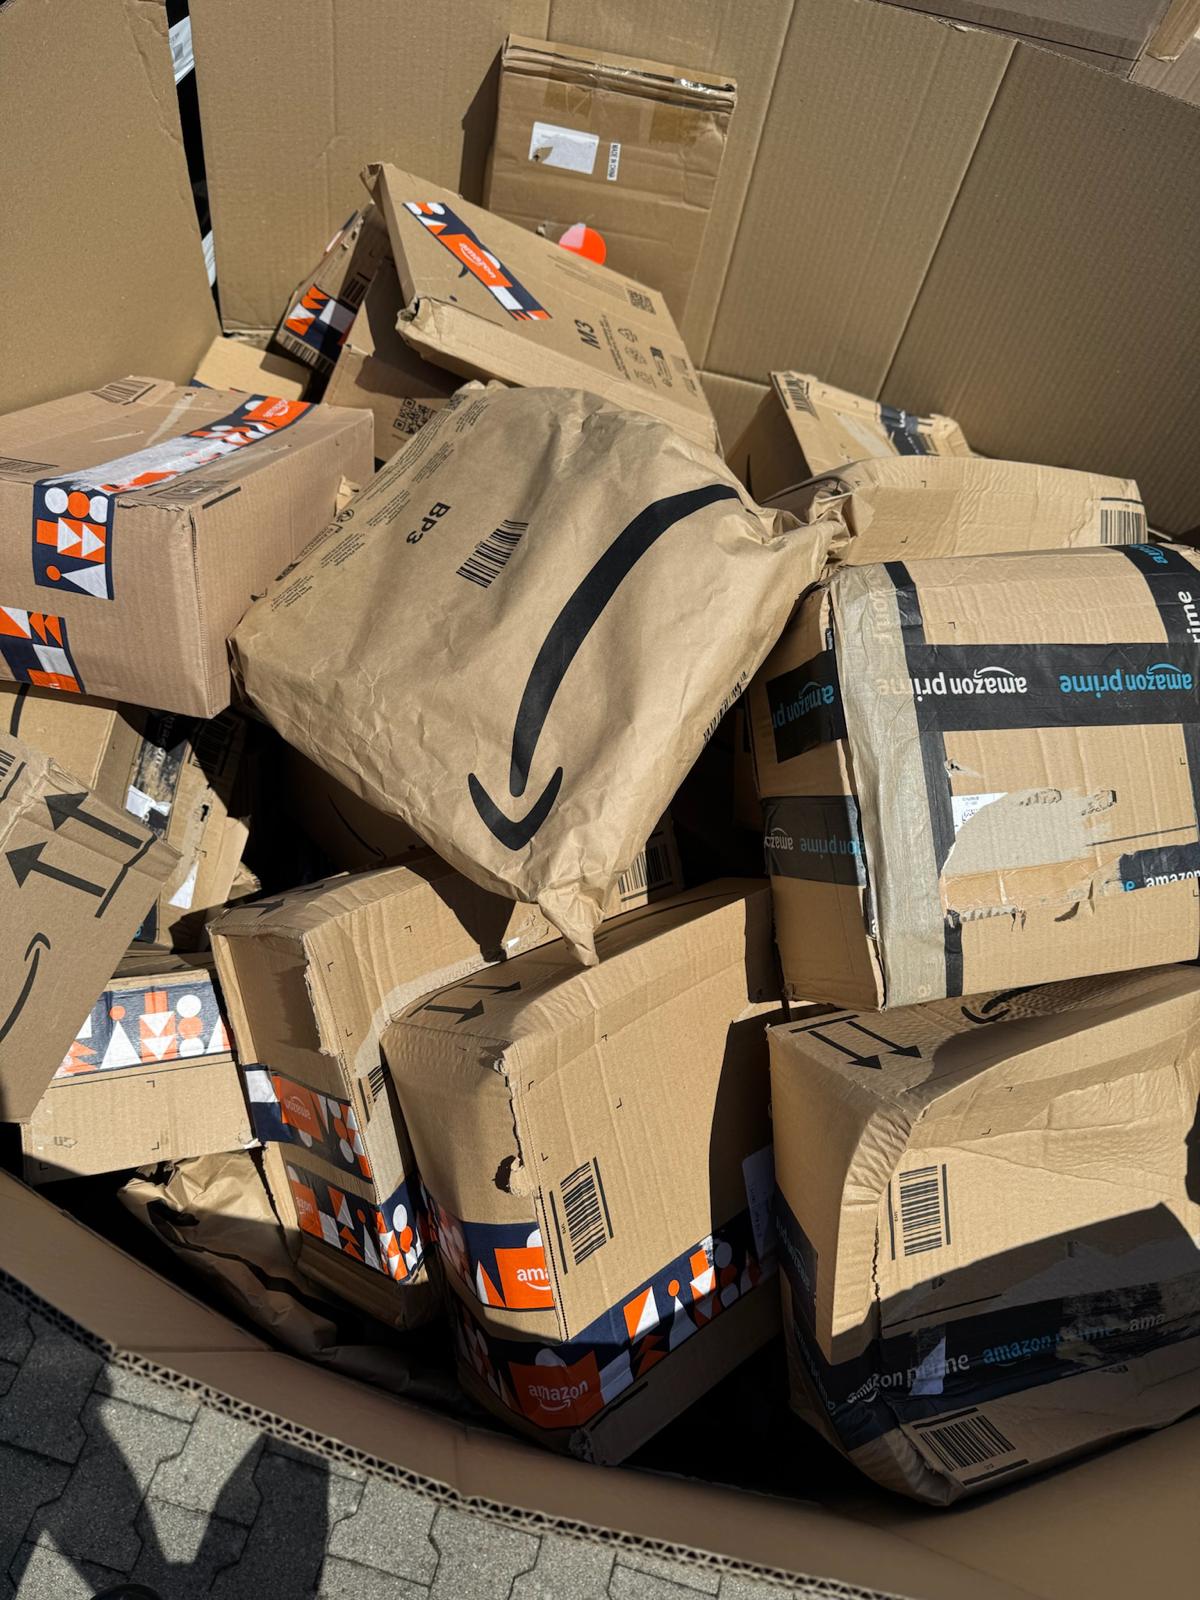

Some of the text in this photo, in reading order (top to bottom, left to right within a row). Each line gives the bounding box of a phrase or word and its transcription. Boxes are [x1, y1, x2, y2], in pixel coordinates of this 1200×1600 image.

[459, 242, 497, 279] amazon
[574, 319, 601, 350] M3
[406, 502, 451, 544] BP3
[950, 675, 1028, 695] amazon
[1059, 668, 1193, 698] amazon prime
[786, 684, 835, 723] amazon
[847, 1371, 904, 1403] amazon
[982, 1333, 1051, 1365] amazon
[528, 1380, 589, 1402] amazon
